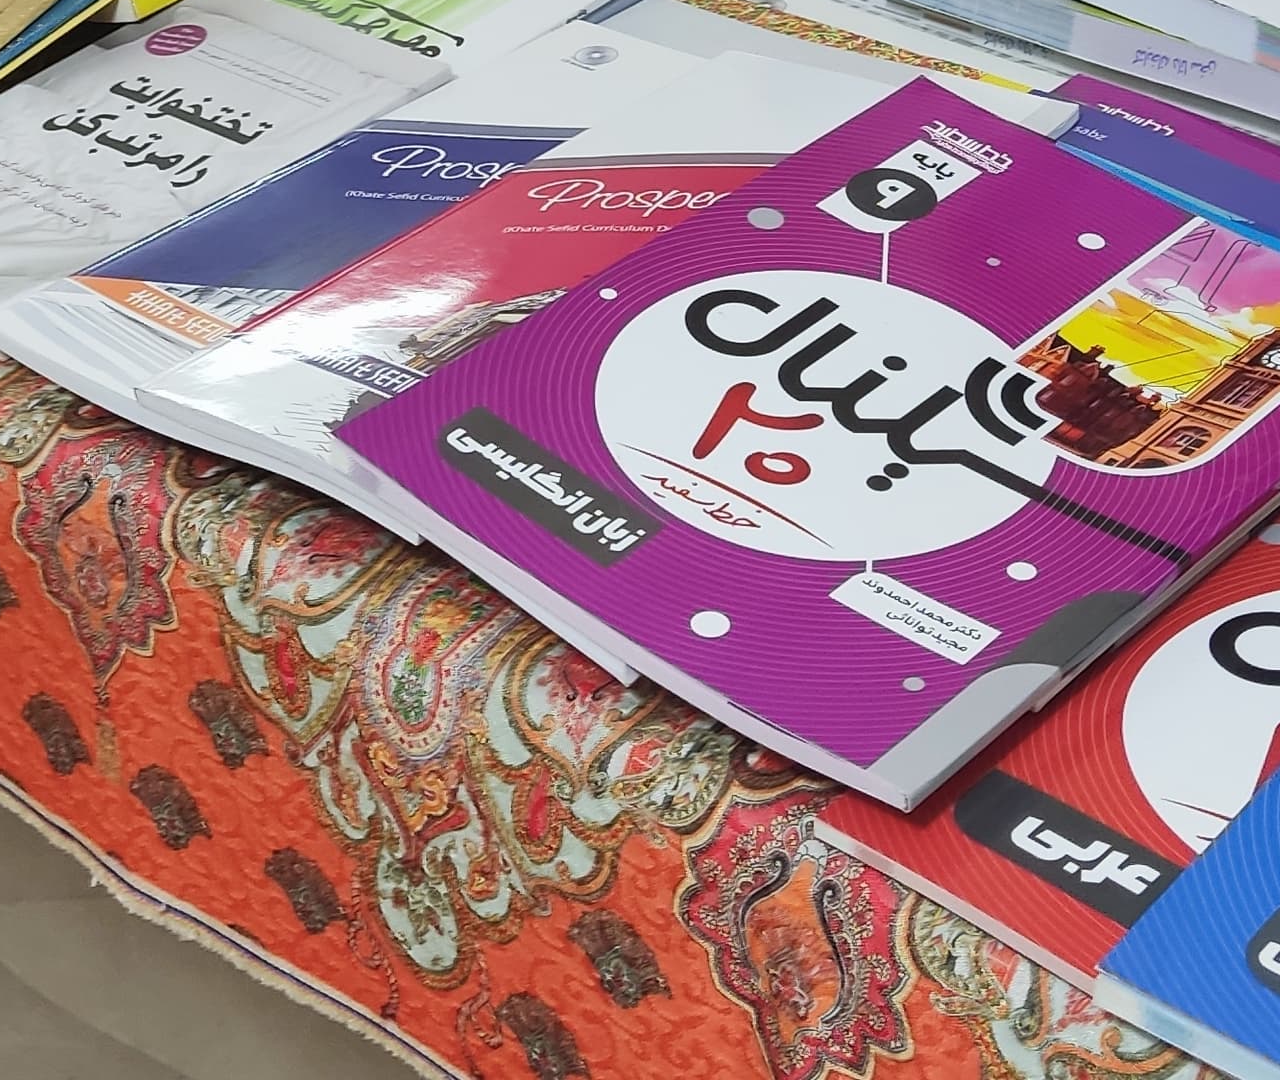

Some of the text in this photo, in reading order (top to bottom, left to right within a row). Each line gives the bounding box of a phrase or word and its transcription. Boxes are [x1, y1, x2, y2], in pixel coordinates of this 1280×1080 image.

[109, 74, 274, 144] تختخوابت
[41, 107, 211, 190] را مرتب کن
[911, 150, 957, 180] پایه
[874, 177, 910, 209] ۹
[582, 223, 652, 235] Curriculum
[684, 288, 1140, 532] سیگنال
[692, 381, 826, 487] ۲۰
[444, 425, 649, 553] زبان انگلیسی
[639, 469, 765, 532] خط سفید
[860, 576, 984, 646] دکتر محمد احمدوند
[935, 635, 970, 656] مجید
[1011, 814, 1162, 895] عربی
